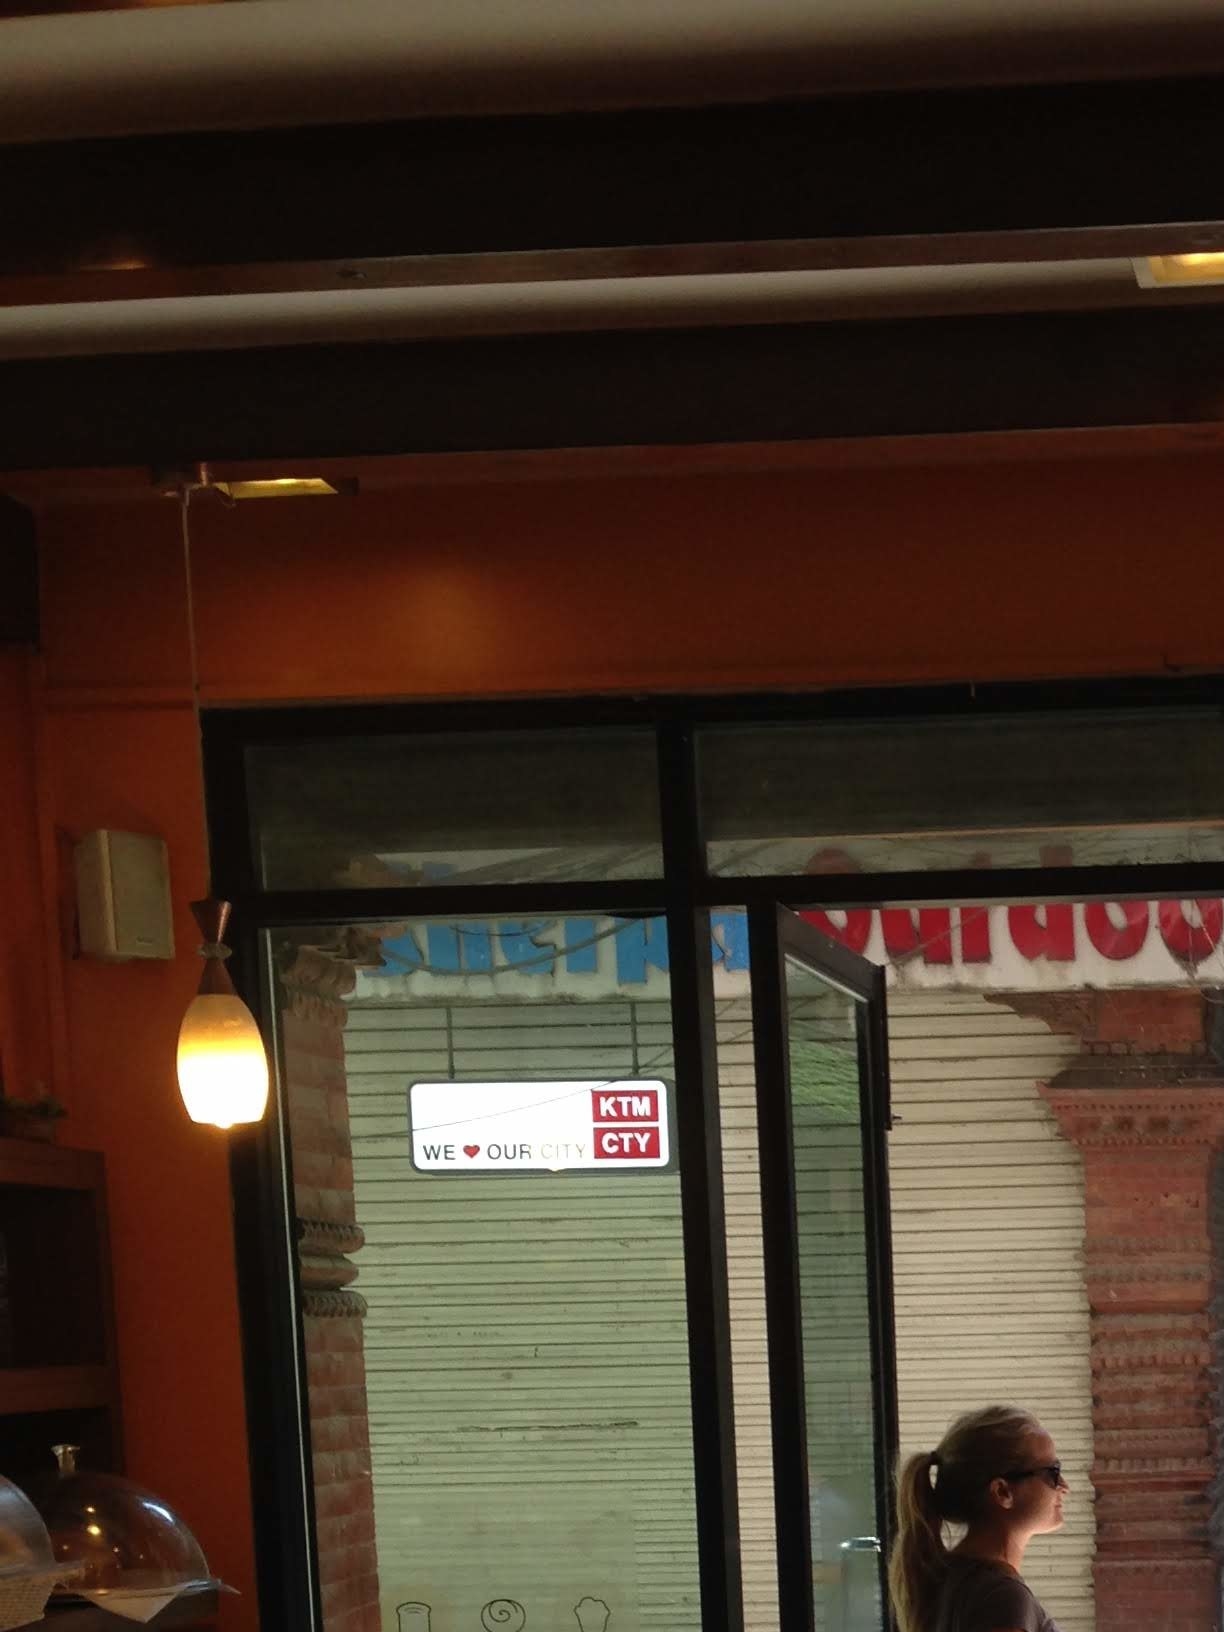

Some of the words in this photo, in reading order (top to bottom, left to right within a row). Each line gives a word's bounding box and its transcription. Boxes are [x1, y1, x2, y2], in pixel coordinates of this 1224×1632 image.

[599, 1096, 651, 1117] KTM
[423, 1144, 456, 1161] WE
[487, 1143, 532, 1160] OUR
[541, 1142, 587, 1160] CITY
[602, 1132, 652, 1154] CTY
